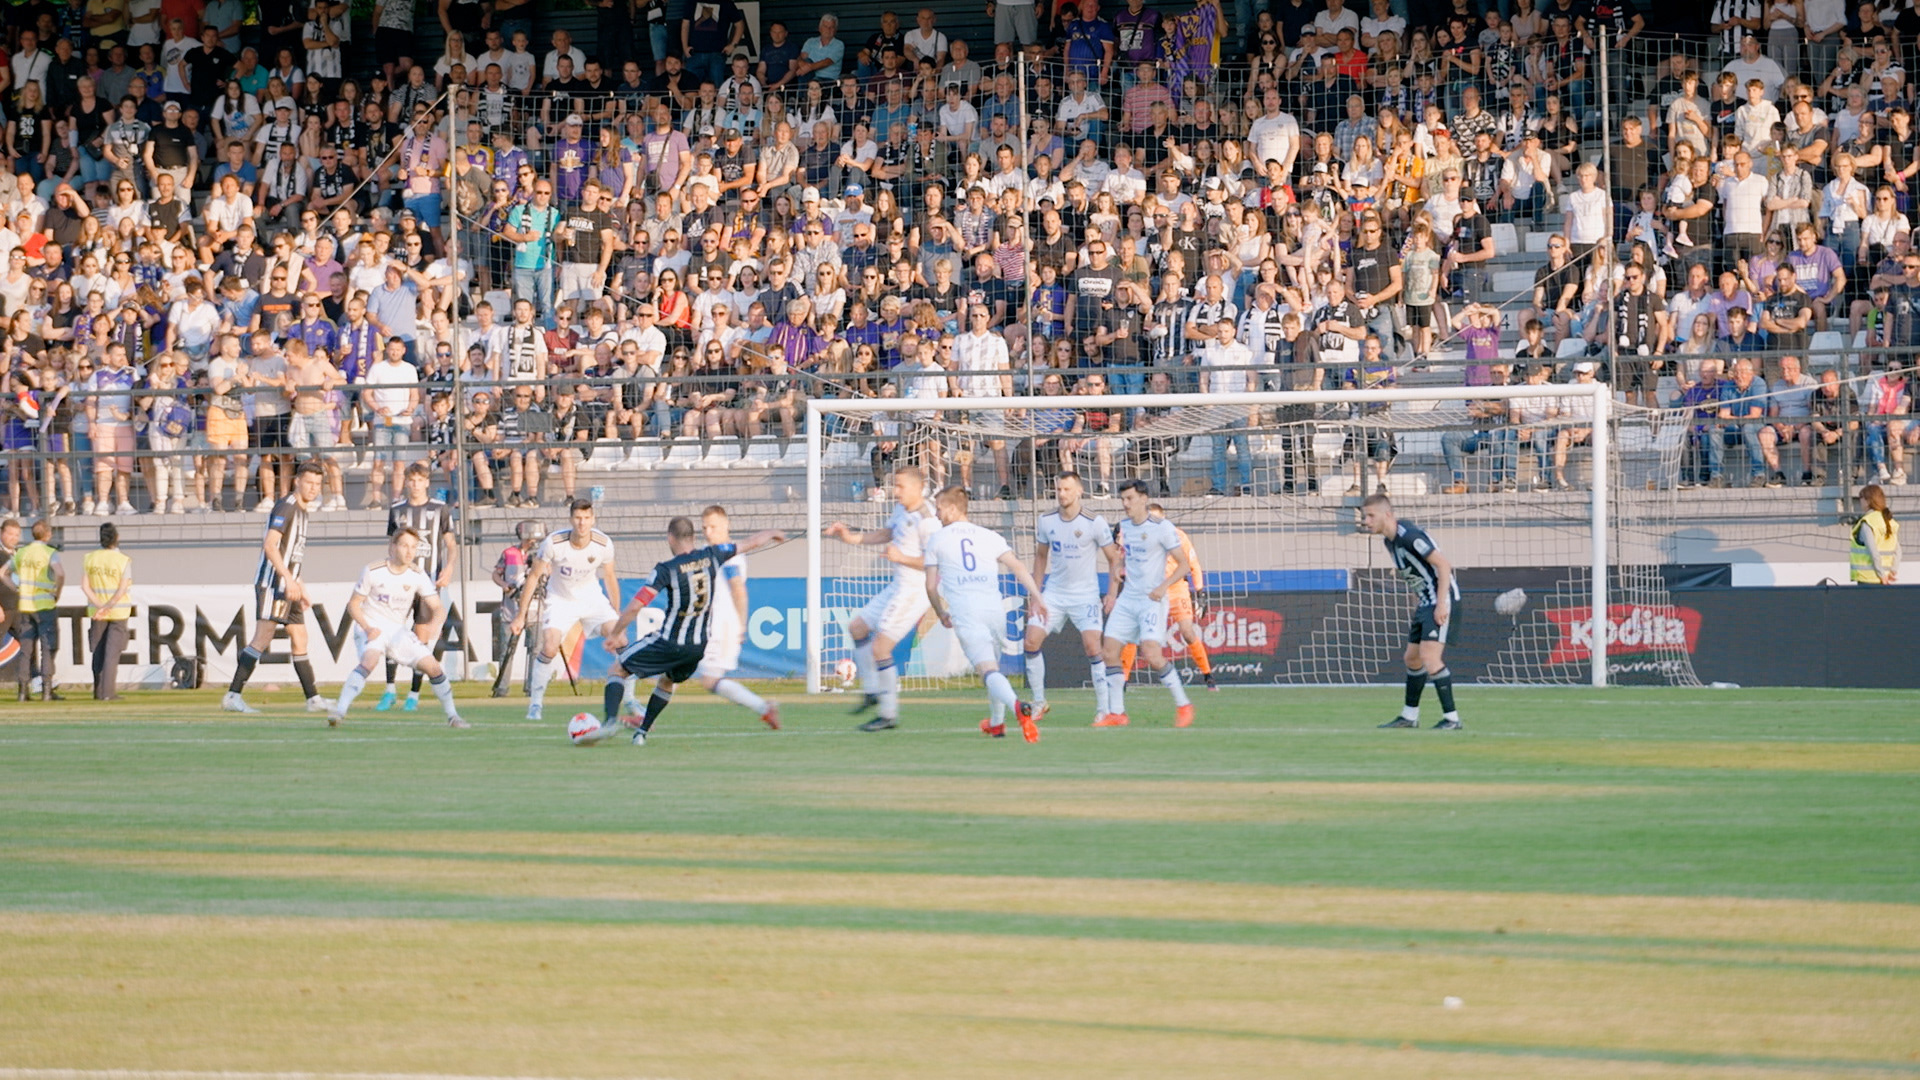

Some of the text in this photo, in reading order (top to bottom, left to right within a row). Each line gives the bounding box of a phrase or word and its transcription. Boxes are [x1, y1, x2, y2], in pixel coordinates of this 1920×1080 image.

[728, 9, 757, 57] A
[568, 219, 594, 230] MURA
[960, 538, 976, 572] 6
